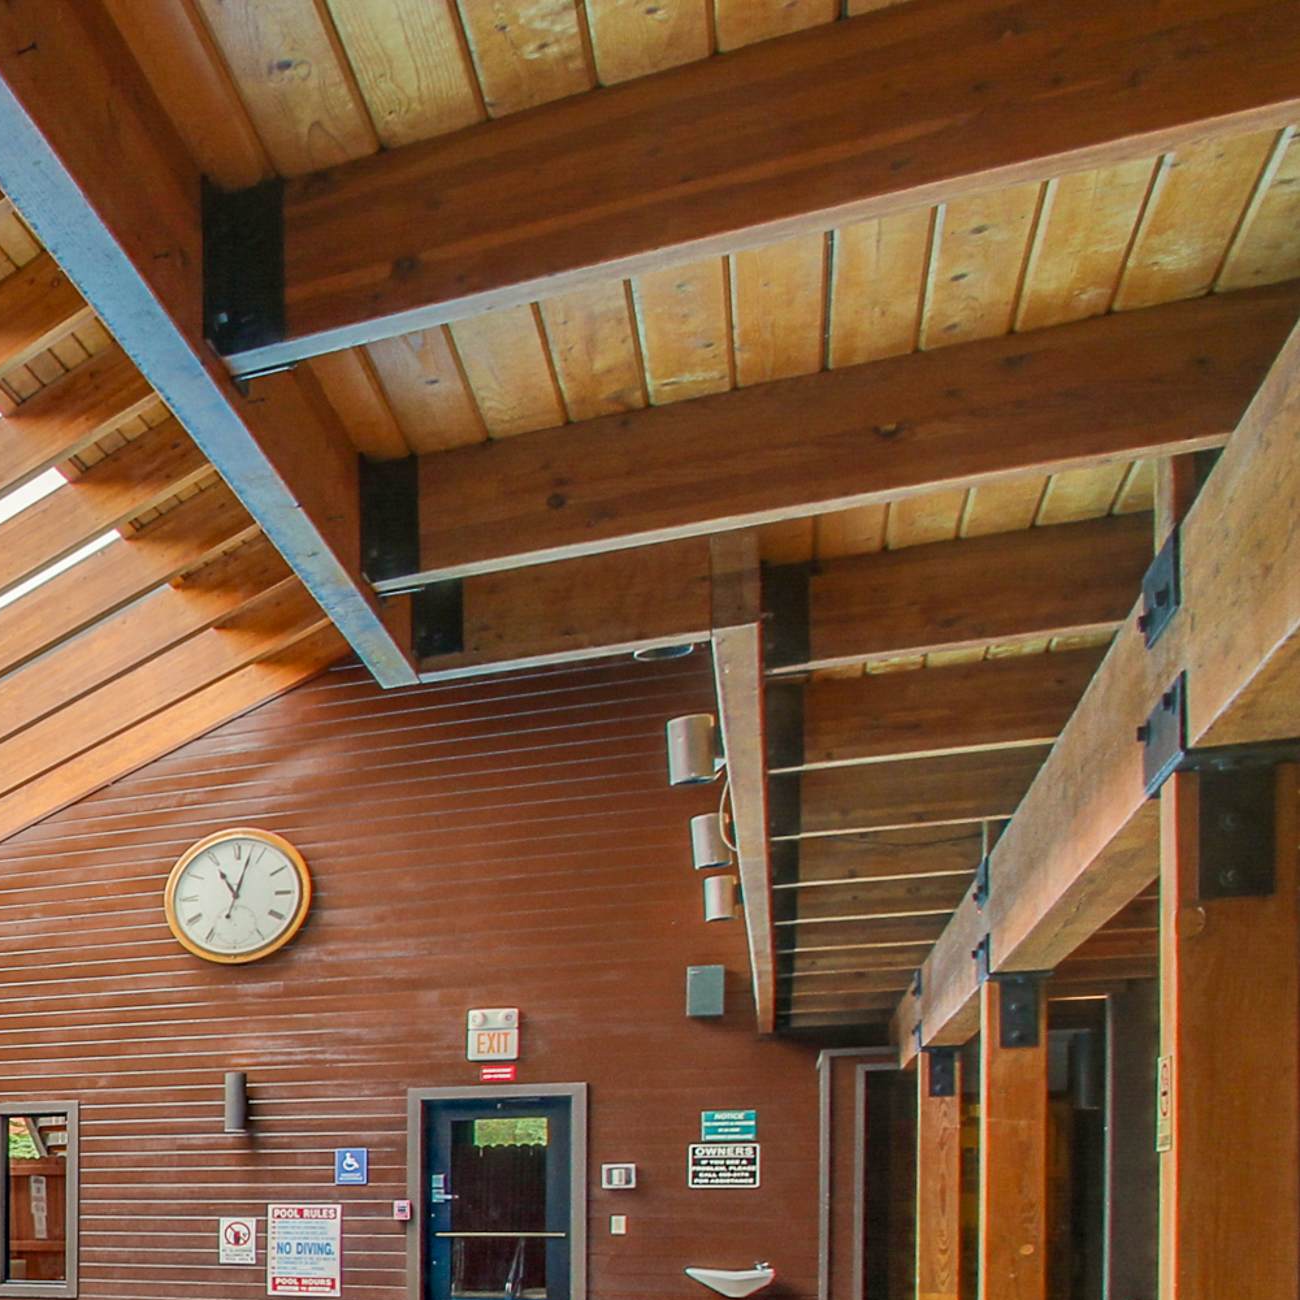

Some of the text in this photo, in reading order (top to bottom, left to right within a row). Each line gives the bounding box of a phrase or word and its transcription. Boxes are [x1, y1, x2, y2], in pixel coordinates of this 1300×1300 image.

[476, 1031, 511, 1055] EXIT
[694, 1147, 754, 1156] OWNERS
[273, 1208, 336, 1218] POOL RULES
[276, 1242, 335, 1256] NO DIVING.
[275, 1278, 297, 1286] POOL
